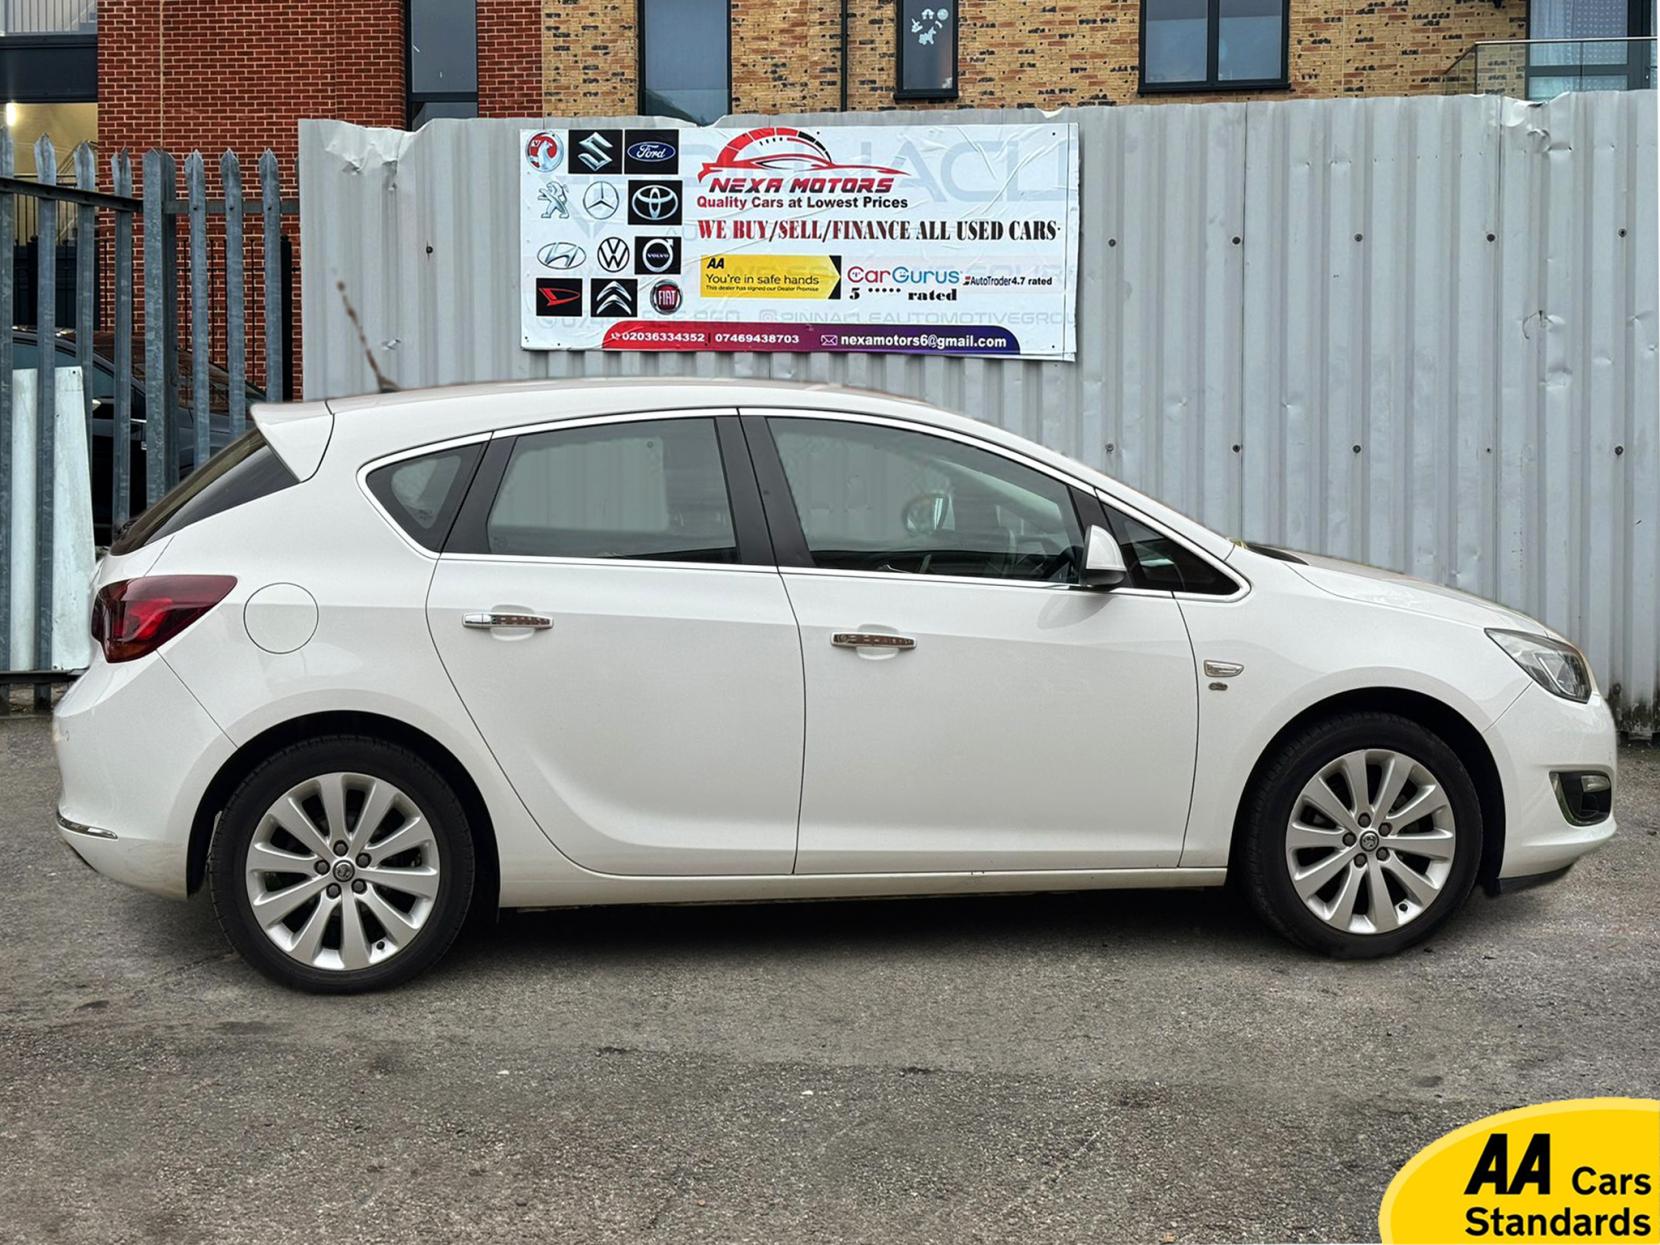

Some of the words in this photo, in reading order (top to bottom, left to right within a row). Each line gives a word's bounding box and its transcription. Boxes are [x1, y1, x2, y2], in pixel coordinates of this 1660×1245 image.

[636, 144, 666, 159] Ford
[709, 178, 784, 193] NEXA
[789, 178, 895, 194] MOTORS
[697, 196, 747, 210] Quality
[752, 196, 784, 208] Cars
[788, 197, 802, 208] at
[807, 197, 858, 208] Lowest
[863, 196, 908, 209] Prices
[697, 220, 727, 239] WE
[915, 221, 951, 240] ALL
[957, 221, 1004, 240] USED
[1008, 221, 1057, 240] CARS
[706, 258, 725, 269] AA
[706, 273, 741, 284] You're
[744, 274, 754, 284] in
[757, 274, 781, 285] safe
[784, 274, 820, 285] hands
[847, 266, 960, 284] CarGurus
[1028, 277, 1052, 286] rated
[658, 289, 677, 306] FIAT
[849, 287, 860, 300] 5
[908, 288, 957, 301] rated
[622, 333, 705, 342] 02036334352
[715, 334, 799, 344] 07469438703
[841, 335, 1007, 349] nexamotors6@gmail.com
